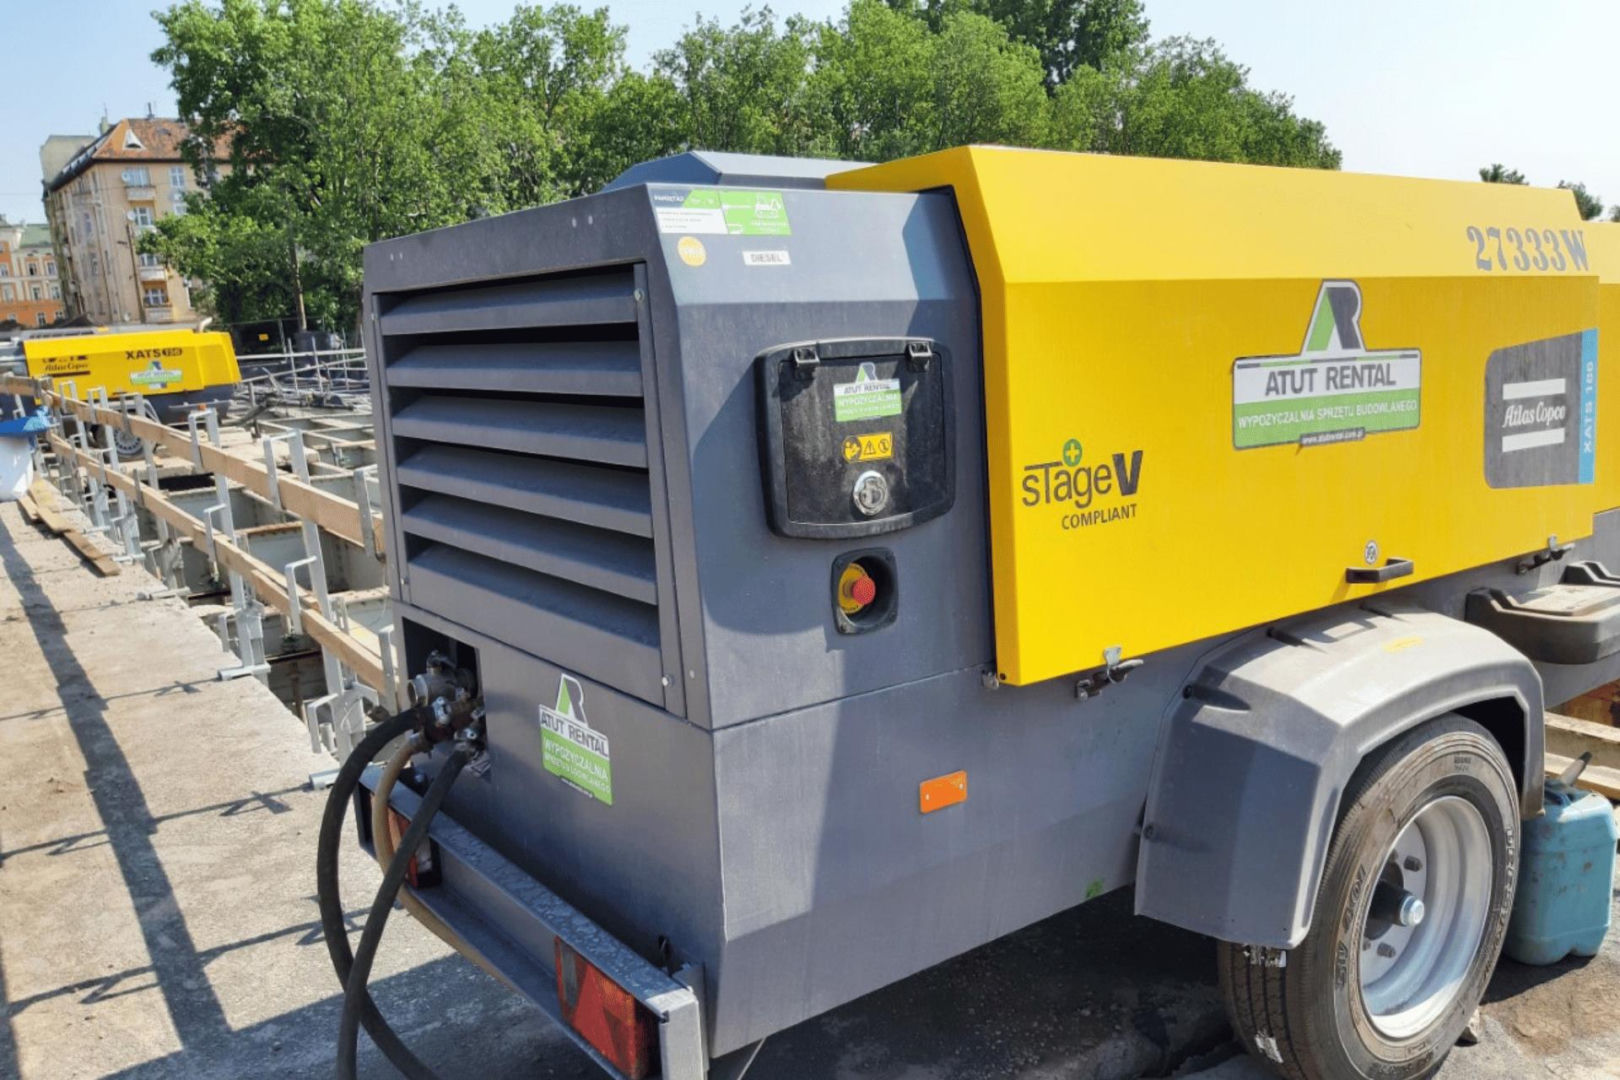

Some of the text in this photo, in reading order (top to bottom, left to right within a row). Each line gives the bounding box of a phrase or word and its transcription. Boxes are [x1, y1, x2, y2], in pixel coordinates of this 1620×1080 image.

[750, 253, 783, 263] DIESEL
[1466, 226, 1589, 271] 27333W
[126, 349, 161, 360] XATS
[1264, 362, 1397, 396] ATUT RENTAL
[1502, 401, 1566, 429] Atlas Copco
[1583, 401, 1593, 454] XATS
[1061, 503, 1138, 530] COMPLIANT
[542, 711, 609, 758] ATUT RENTAL
